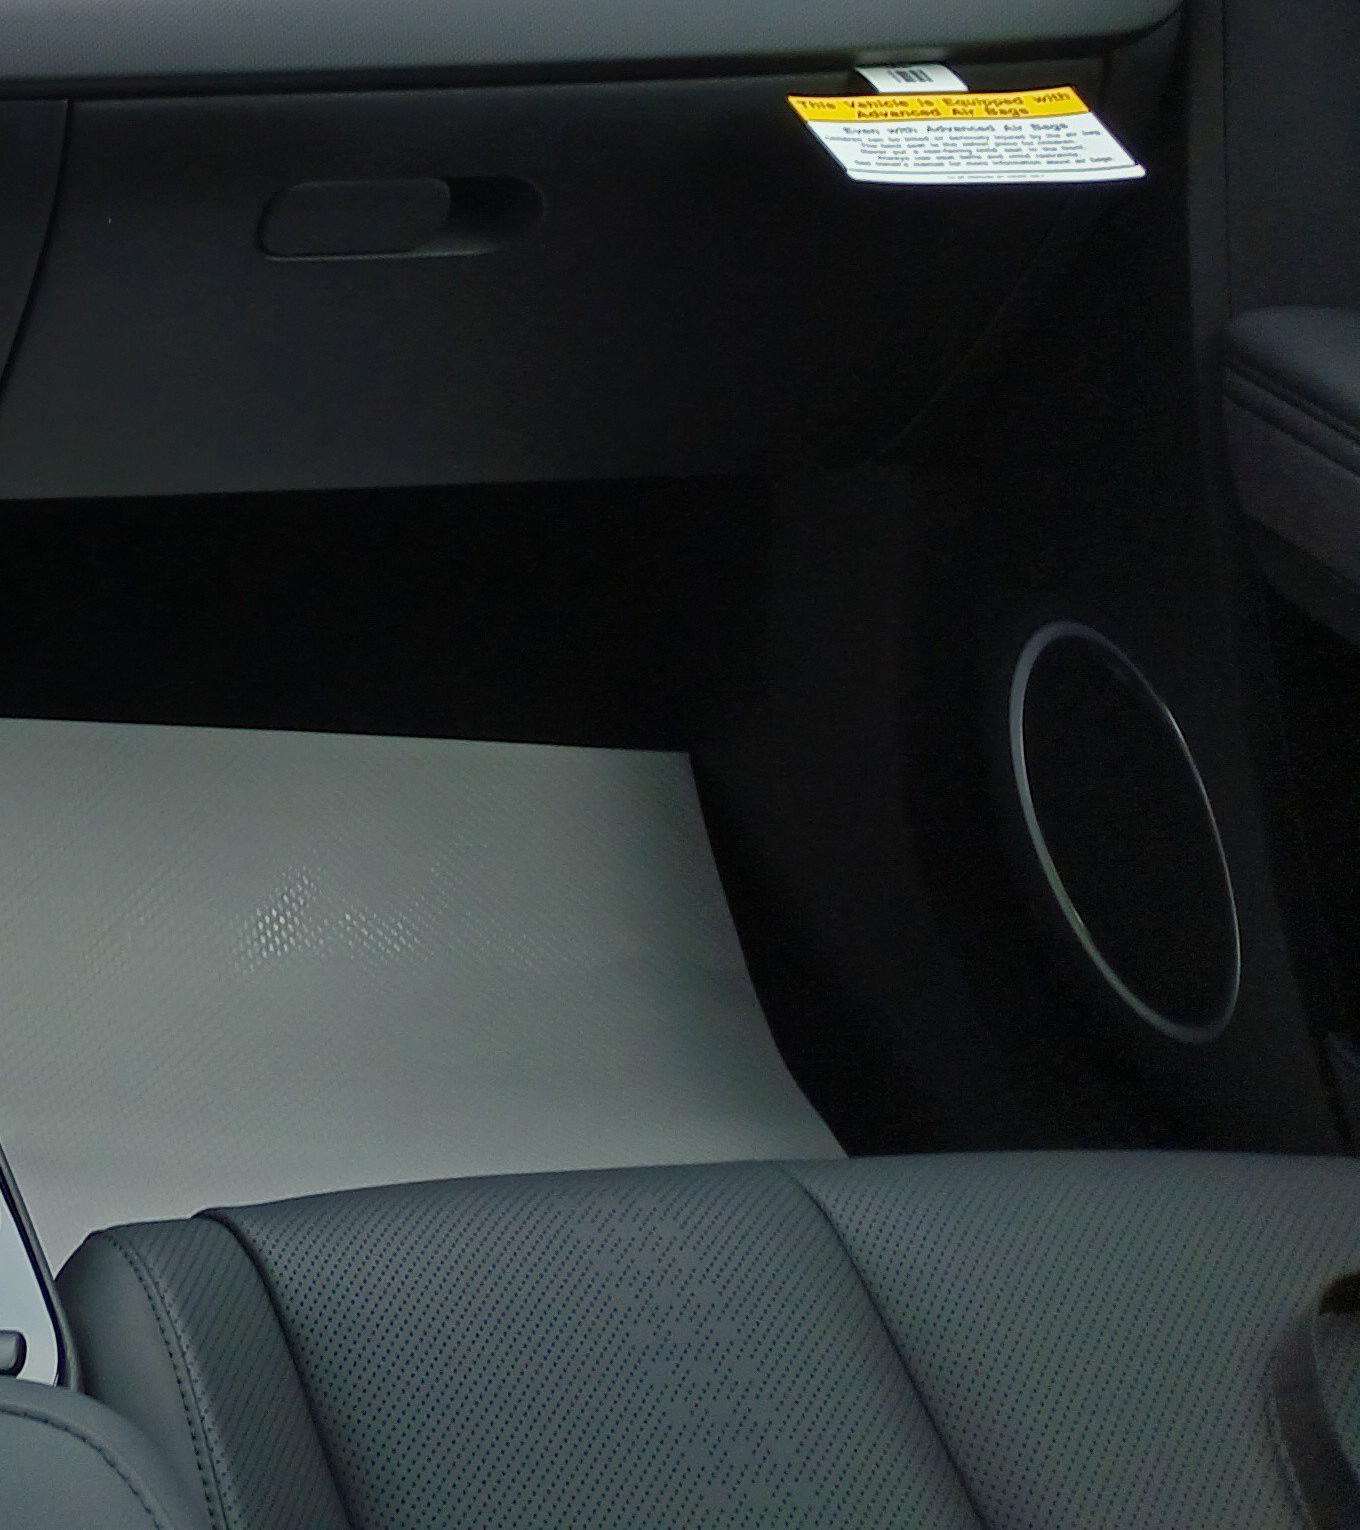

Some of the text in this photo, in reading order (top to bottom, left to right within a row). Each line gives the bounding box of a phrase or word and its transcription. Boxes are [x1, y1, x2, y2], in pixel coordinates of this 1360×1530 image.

[796, 100, 836, 110] This
[844, 98, 910, 110] Vehicle
[942, 96, 1024, 109] Equipped
[857, 107, 1029, 118] Advanced Air Bags
